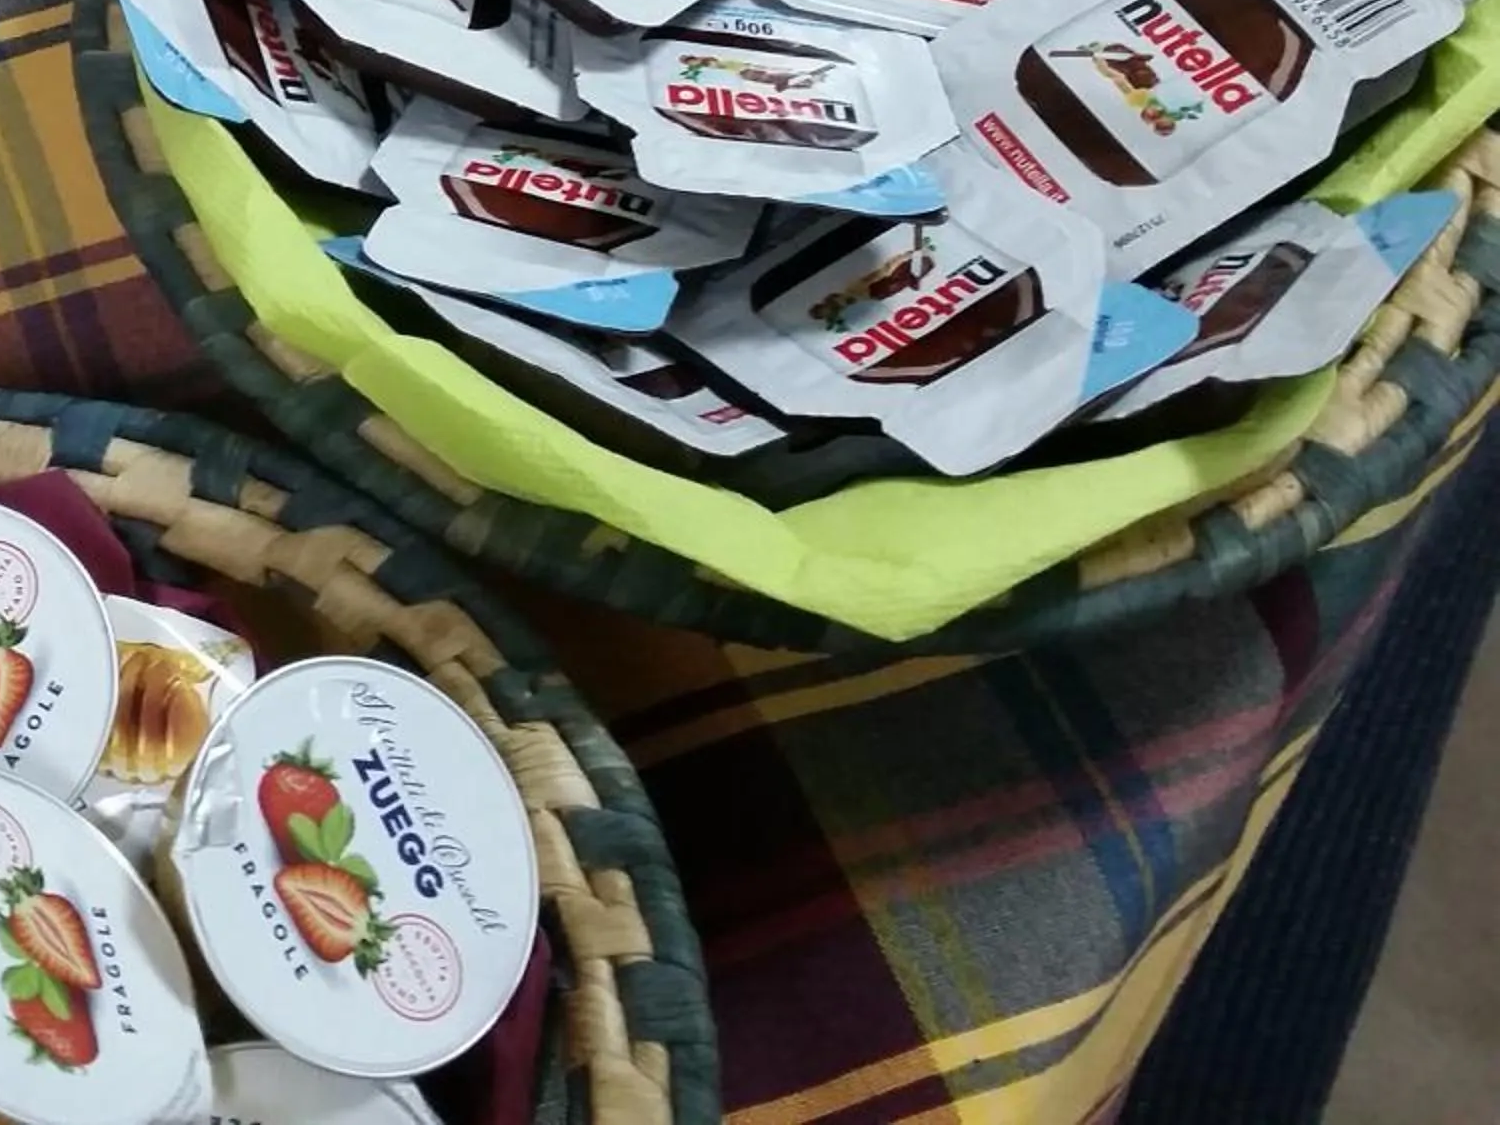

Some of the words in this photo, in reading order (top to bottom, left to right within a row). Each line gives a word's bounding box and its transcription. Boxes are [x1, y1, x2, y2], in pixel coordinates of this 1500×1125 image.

[667, 84, 857, 124] nutella
[464, 161, 655, 216] nutella
[833, 259, 1008, 365] nutella
[3, 679, 65, 769] AGOLE
[351, 747, 444, 899] ZUEGG
[233, 842, 309, 982] FRAGOLE
[91, 906, 138, 1035] FRAGOLE
